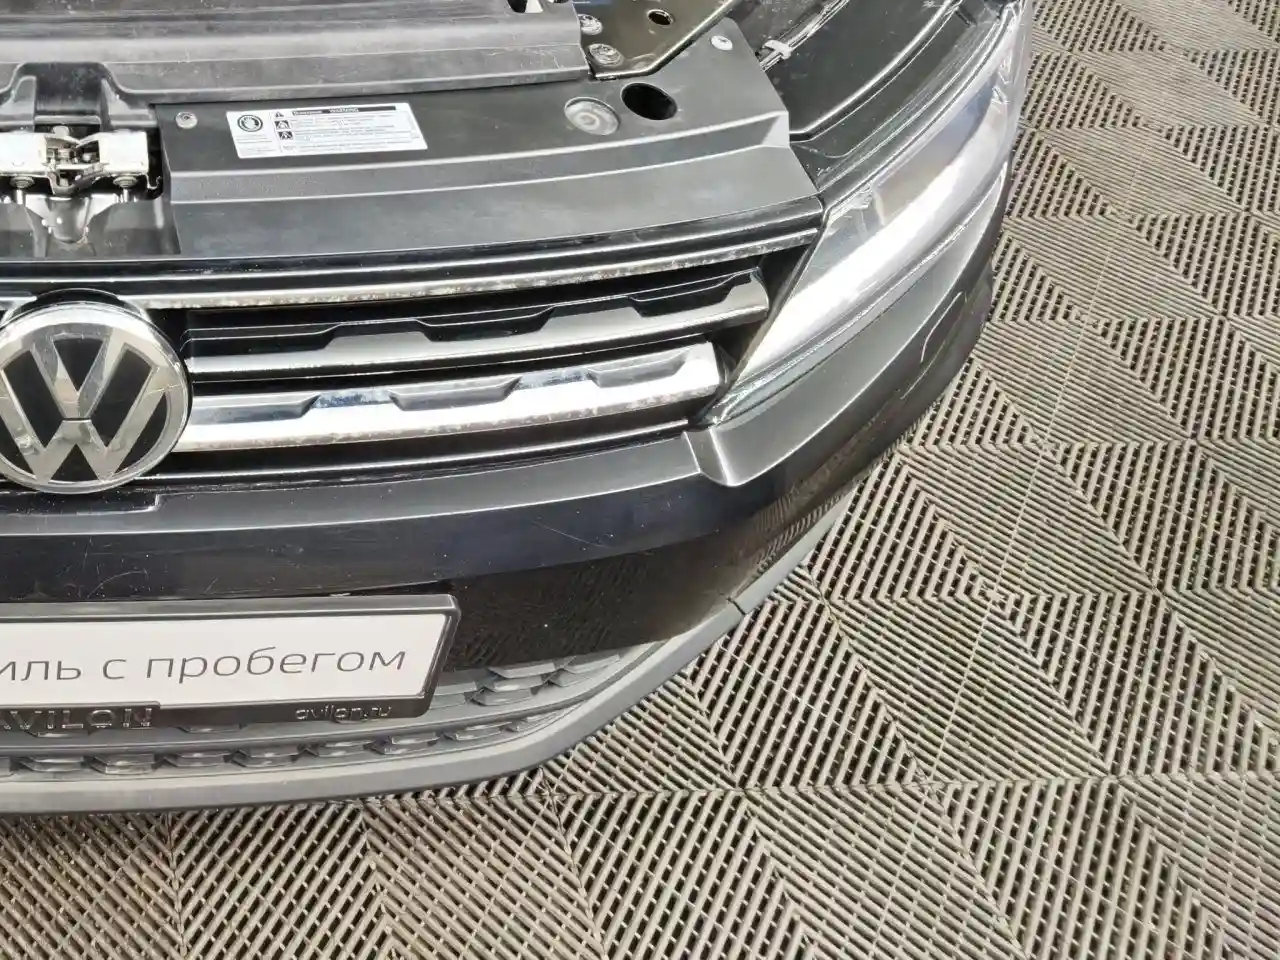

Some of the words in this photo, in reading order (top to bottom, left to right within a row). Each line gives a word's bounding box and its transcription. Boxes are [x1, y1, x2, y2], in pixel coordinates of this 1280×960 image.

[102, 658, 127, 680] с
[146, 646, 406, 684] пробегом
[295, 704, 392, 724] avilon.ru
